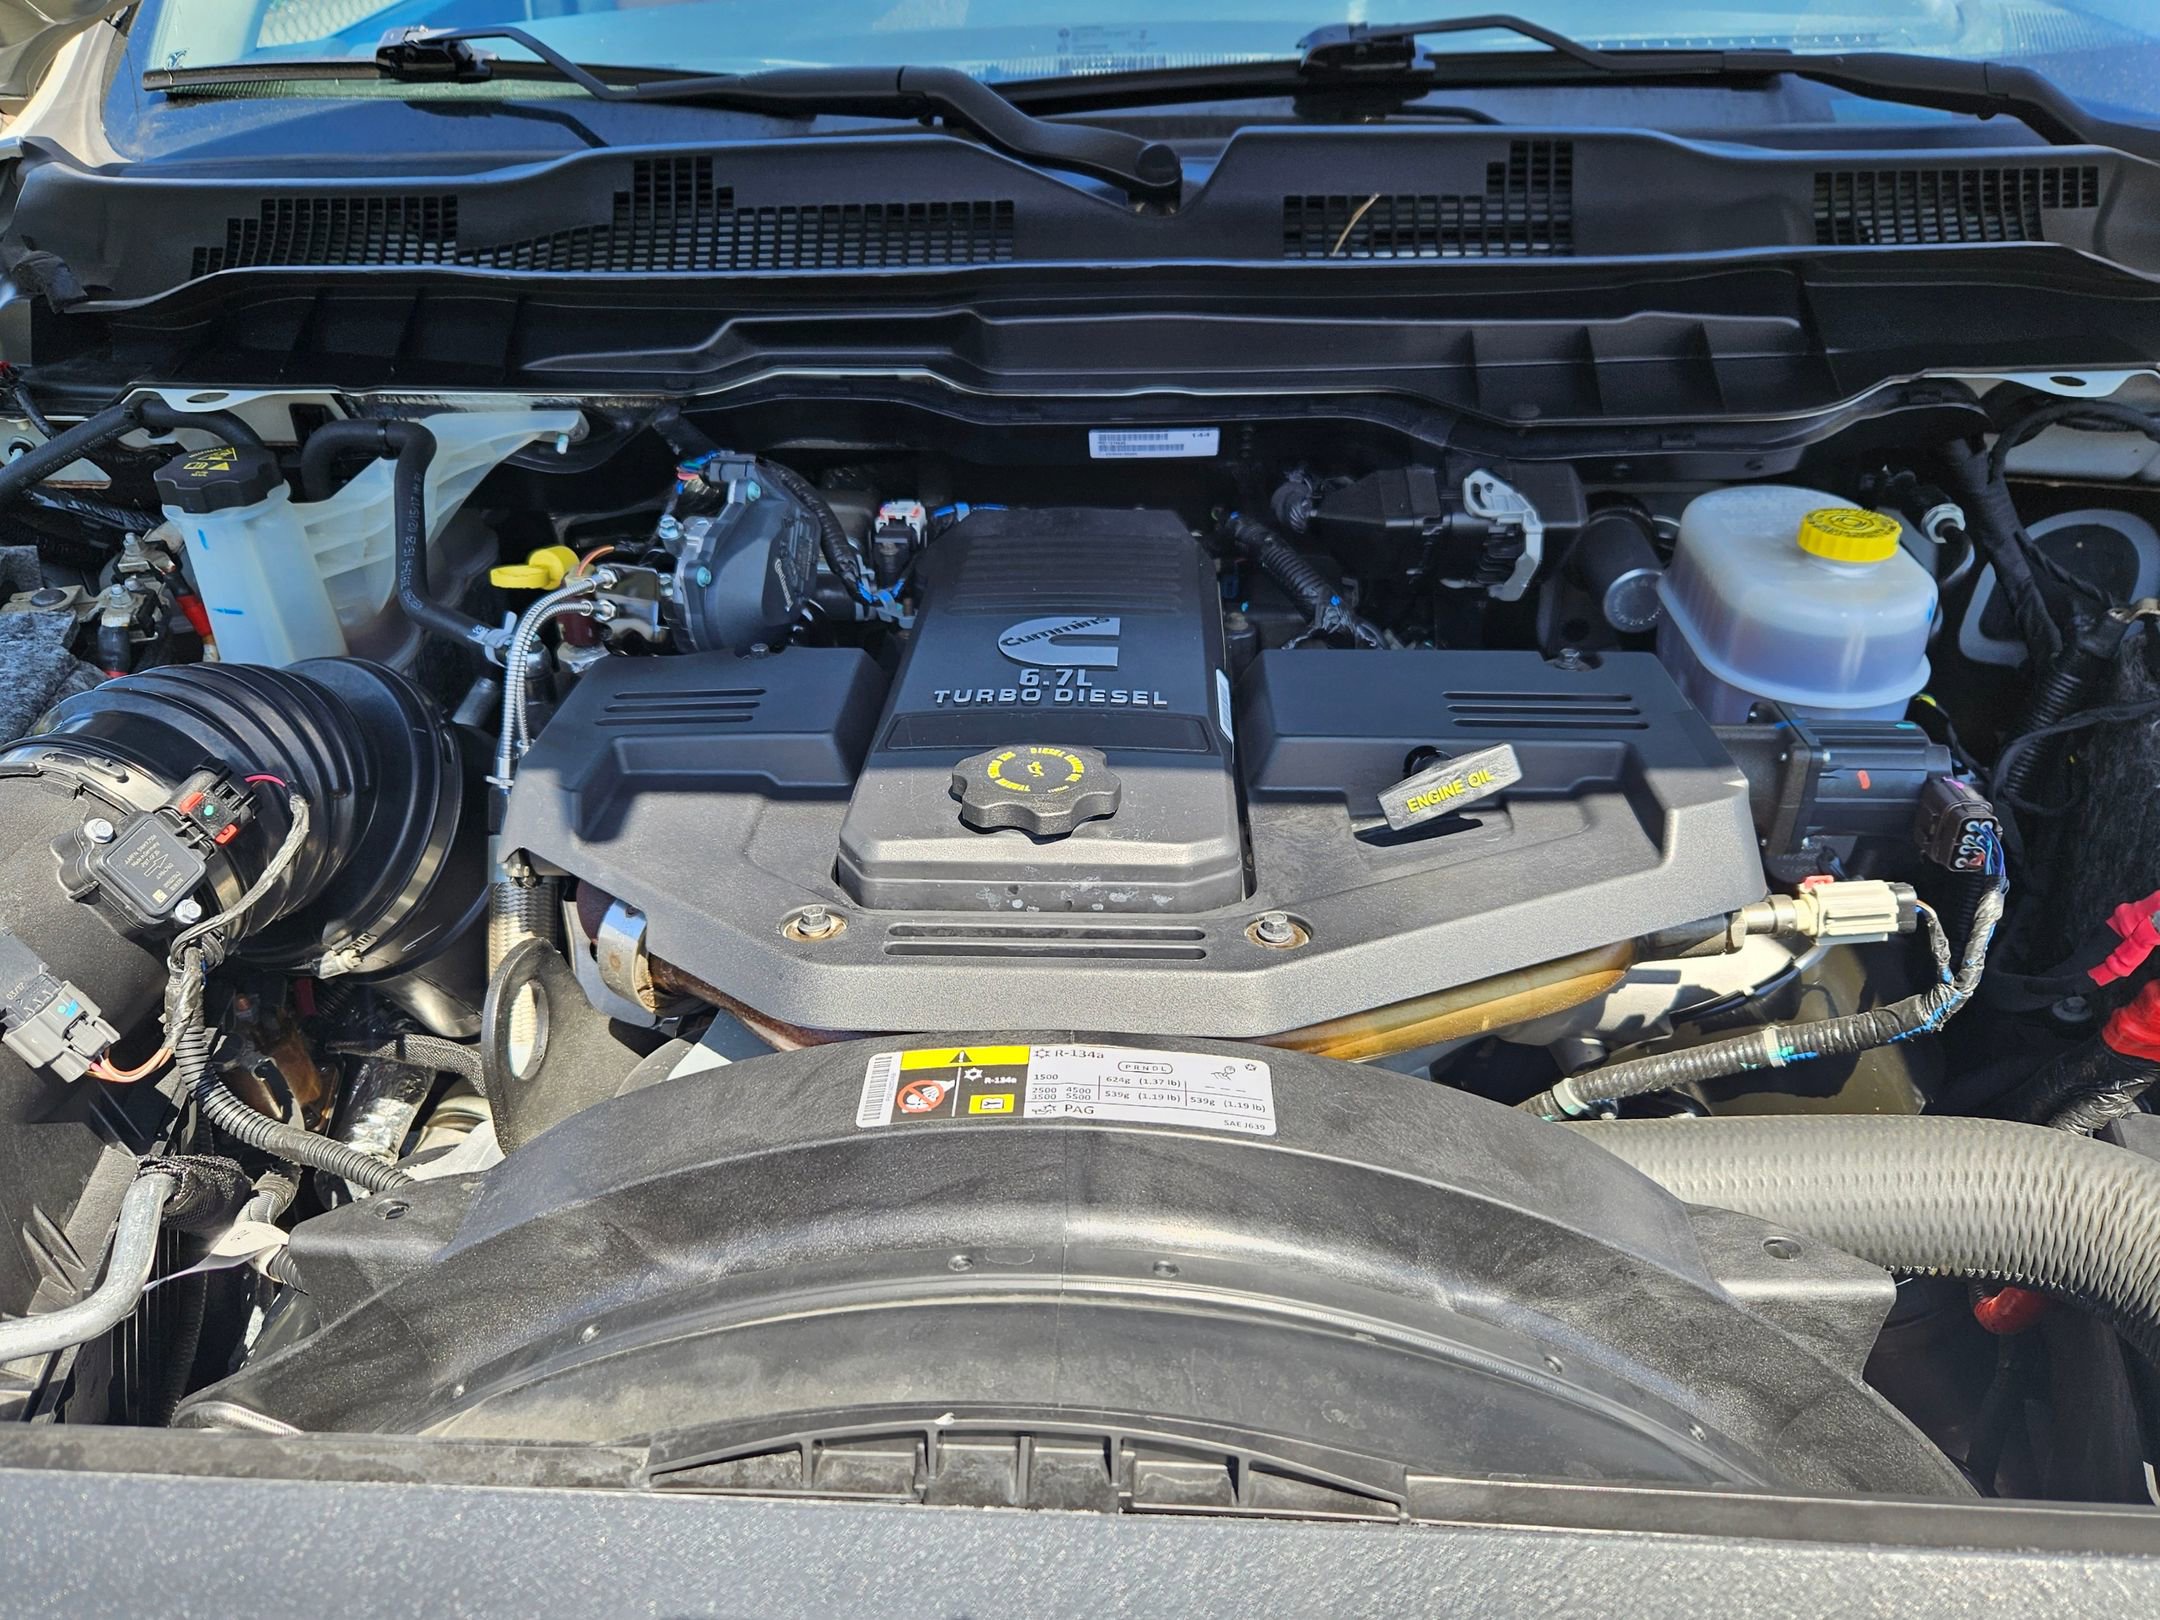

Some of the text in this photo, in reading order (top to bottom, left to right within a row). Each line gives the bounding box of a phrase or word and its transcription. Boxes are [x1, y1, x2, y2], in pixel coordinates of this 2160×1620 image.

[774, 558, 793, 608] Continental
[1001, 616, 1110, 647] Cummins
[1019, 668, 1092, 687] 6.7L
[934, 688, 1168, 705] TURBO DIESEL
[1406, 769, 1495, 813] ENGINE OIL
[6, 982, 25, 1000] 03/17
[1055, 1050, 1104, 1059] R-134a
[1106, 1076, 1181, 1088] 624g (1.37 lb)
[1065, 1093, 1091, 1101] 5500
[1066, 1086, 1091, 1094] 4500
[1105, 1091, 1181, 1102] 539g (1.19 lb)
[1064, 1104, 1095, 1115] PAG
[1190, 1096, 1266, 1113] 539g (1.19 lb)
[1224, 1119, 1266, 1131] SAE J639
